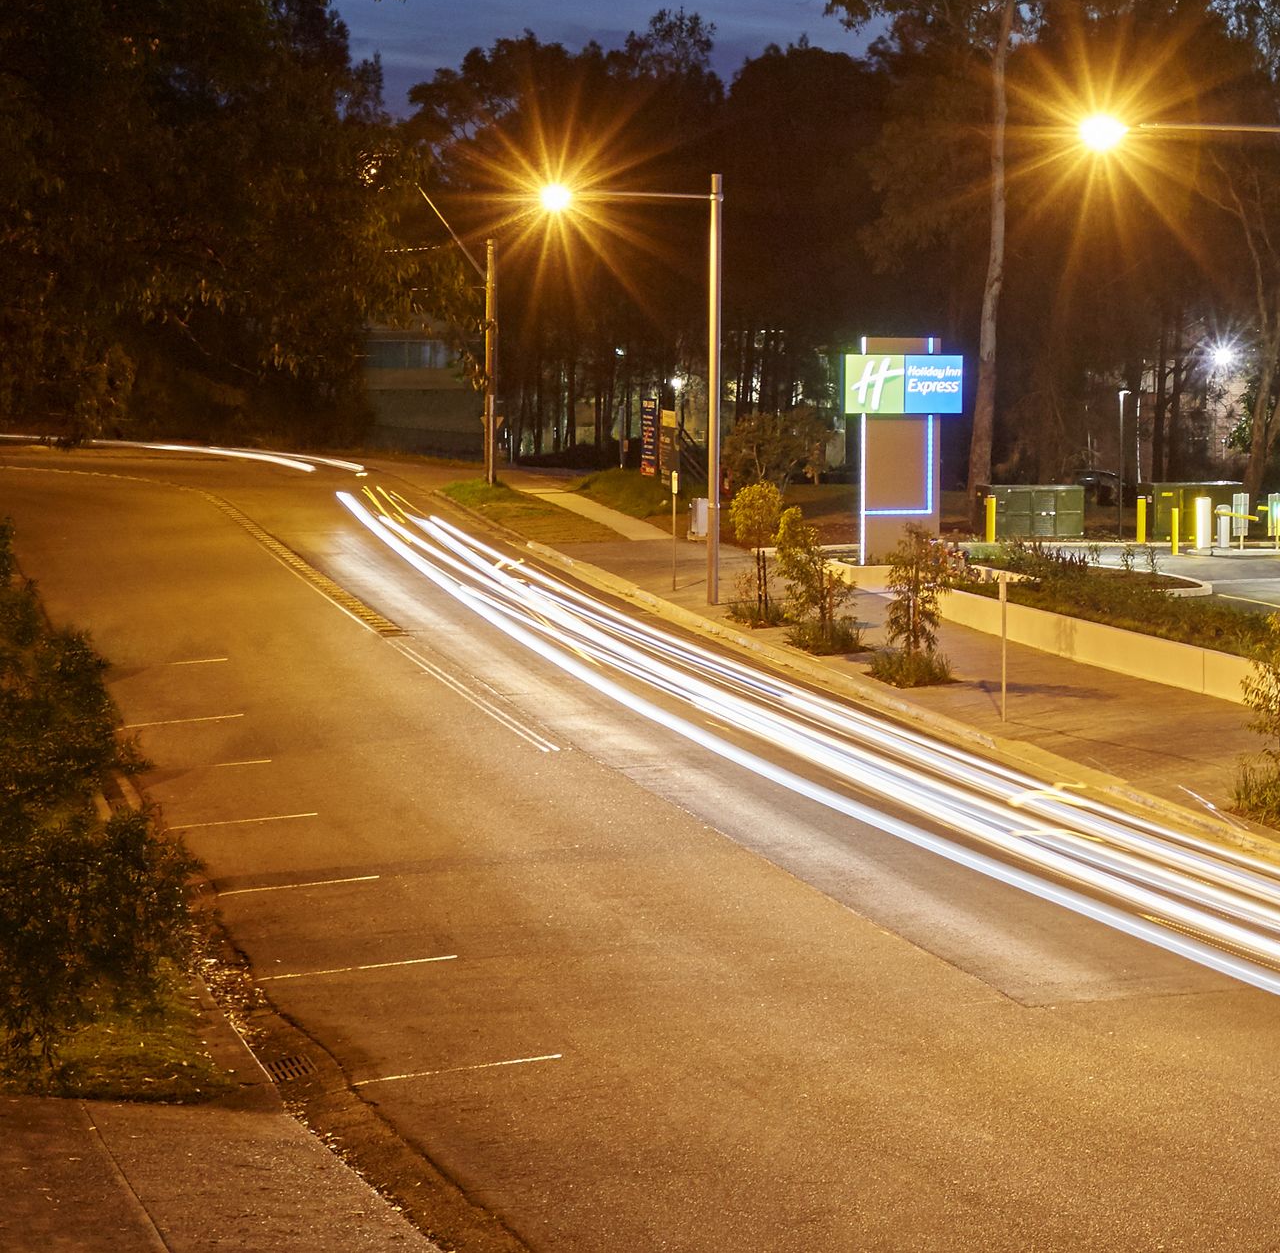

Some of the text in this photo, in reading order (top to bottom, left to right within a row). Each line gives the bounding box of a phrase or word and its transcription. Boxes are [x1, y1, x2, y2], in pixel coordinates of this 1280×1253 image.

[907, 365, 945, 379] Holiday
[944, 366, 961, 376] Inn
[907, 378, 960, 395] Express
